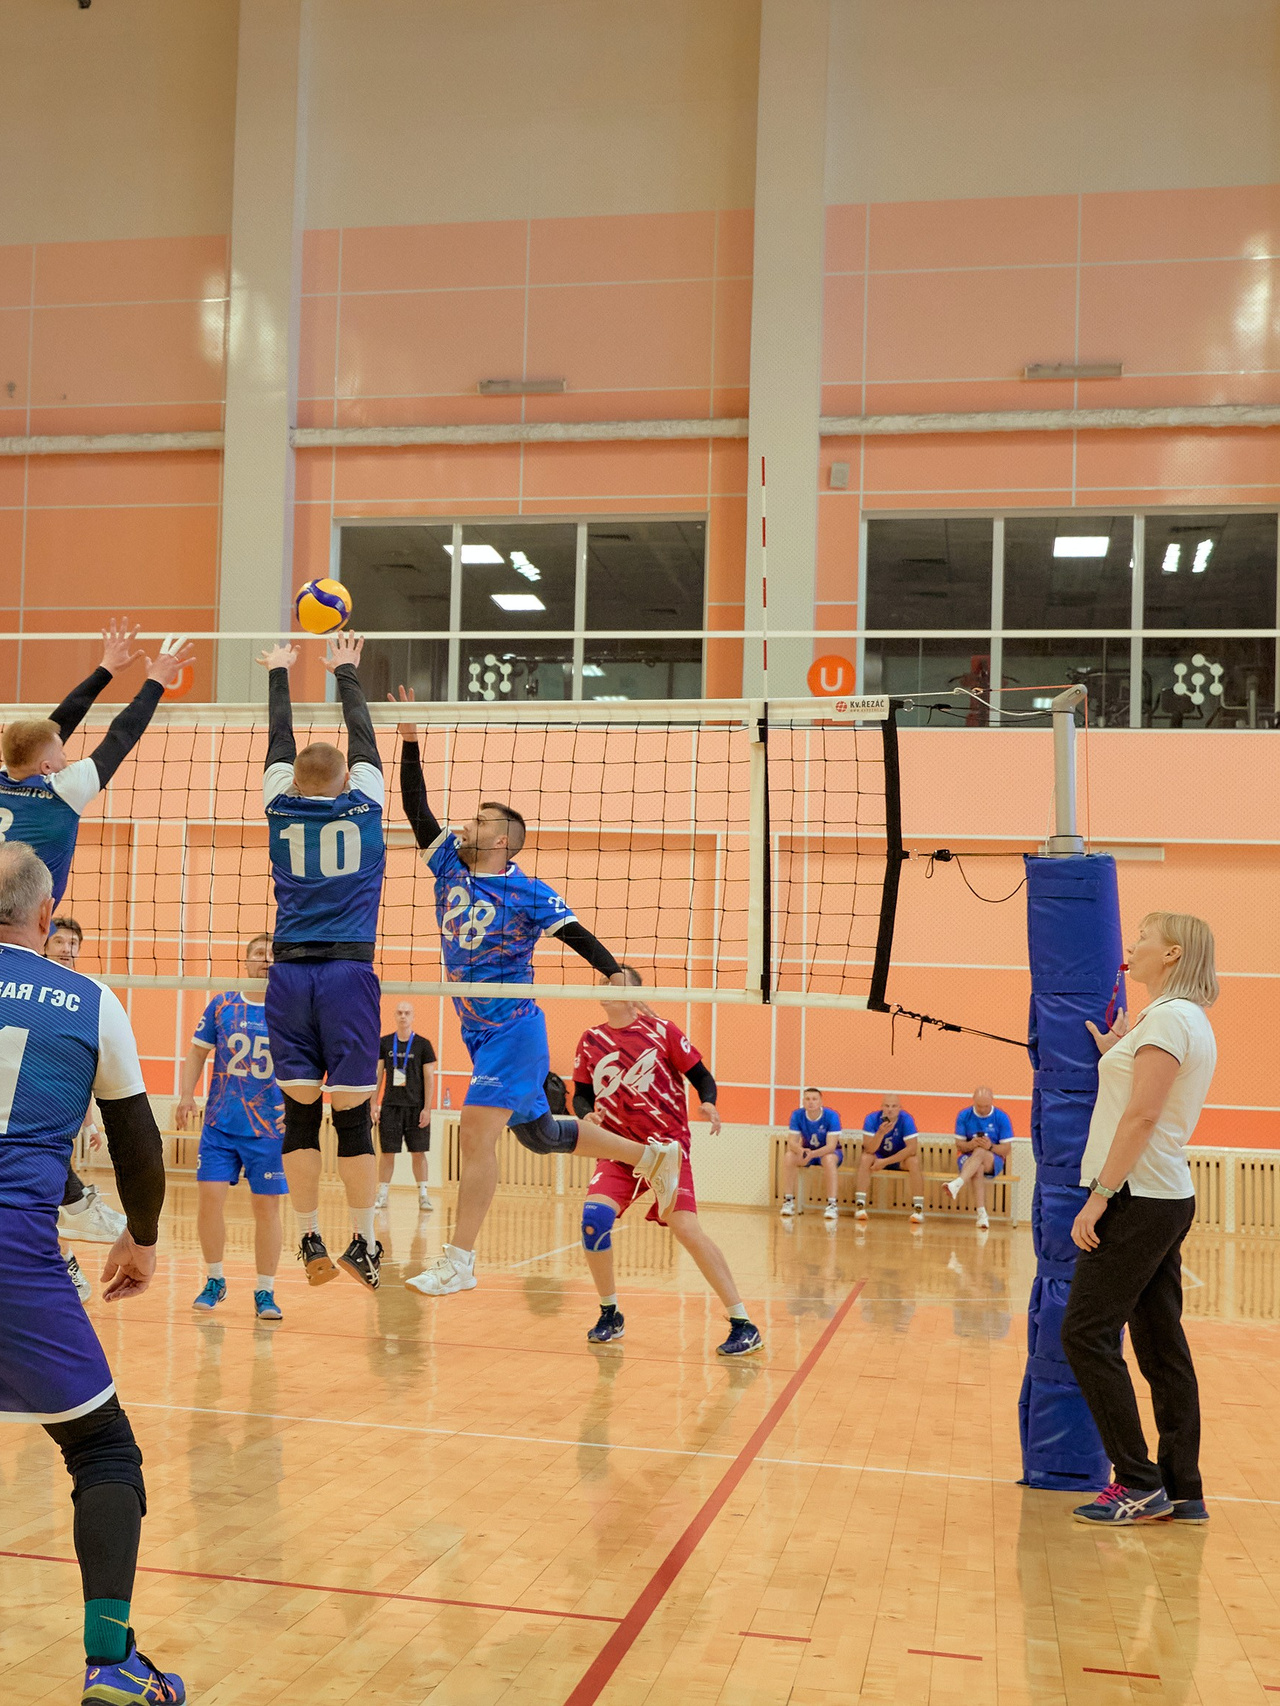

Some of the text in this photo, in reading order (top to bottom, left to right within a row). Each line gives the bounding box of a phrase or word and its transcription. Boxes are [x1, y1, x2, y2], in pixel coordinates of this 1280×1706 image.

[820, 667, 844, 692] U
[279, 820, 362, 878] 10
[442, 886, 496, 950] 28
[37, 986, 81, 1012] ГЭС
[195, 1015, 206, 1032] 5
[227, 1033, 274, 1080] 25
[592, 1048, 658, 1100] 64
[810, 1133, 820, 1147] 4
[883, 1136, 893, 1152] 5
